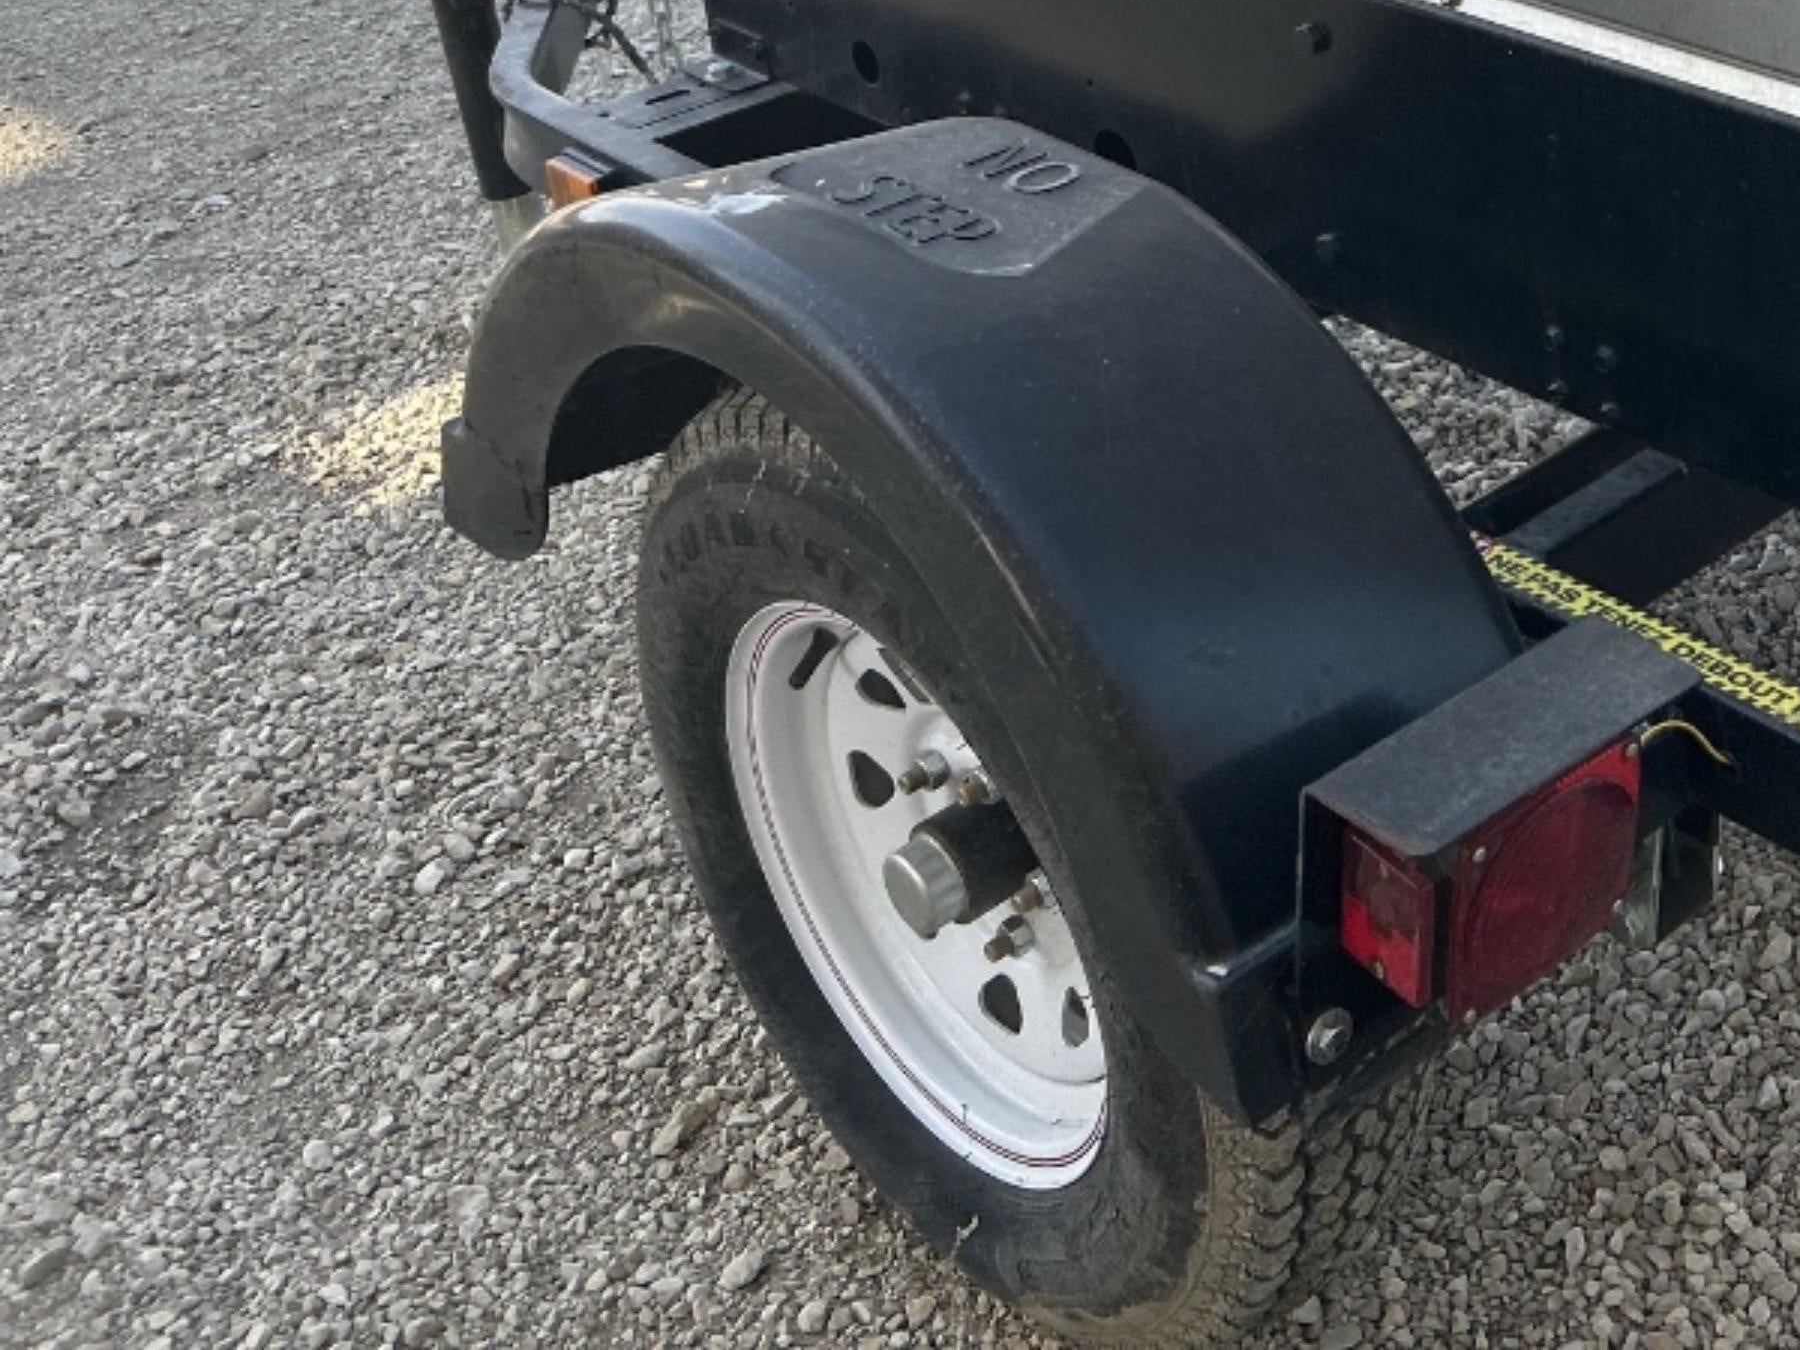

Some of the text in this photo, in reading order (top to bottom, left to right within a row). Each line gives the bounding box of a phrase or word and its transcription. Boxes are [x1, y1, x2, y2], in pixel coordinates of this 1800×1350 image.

[959, 143, 1081, 195] NO
[828, 175, 1002, 245] STEP
[1670, 641, 1793, 704] DEBOUT
